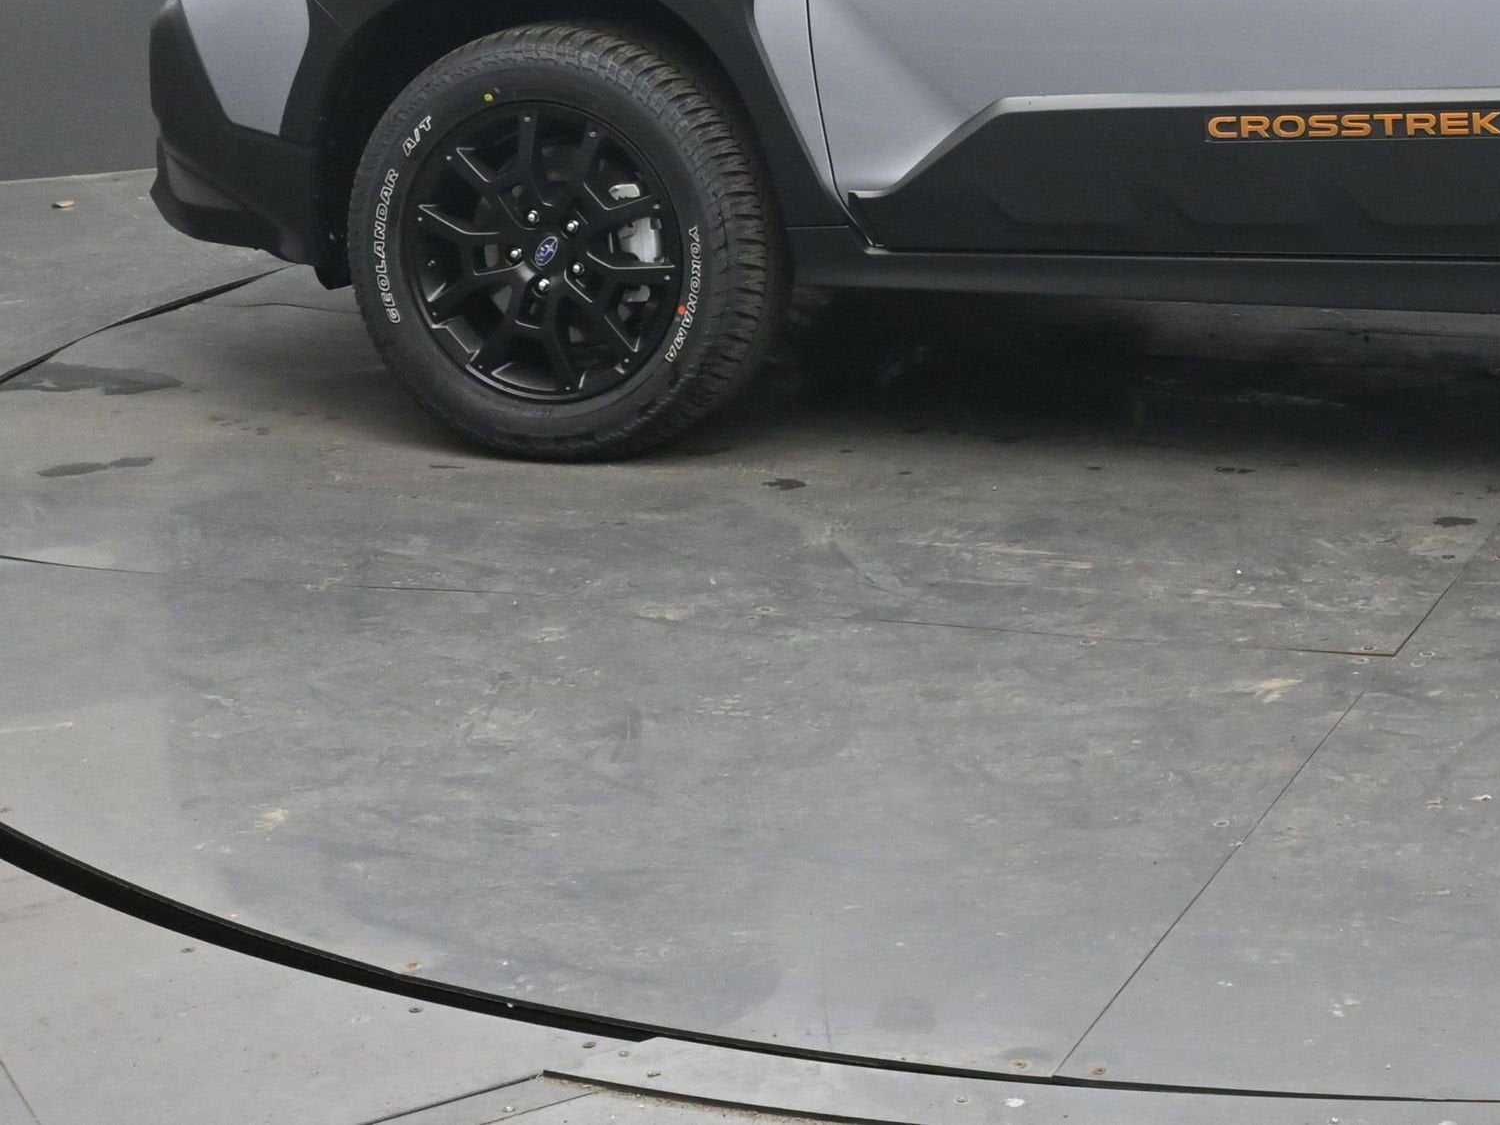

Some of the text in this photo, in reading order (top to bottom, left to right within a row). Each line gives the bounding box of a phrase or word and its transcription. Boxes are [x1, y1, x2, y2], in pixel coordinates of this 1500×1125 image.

[373, 115, 432, 324] GEOLANDAR A/T
[664, 225, 701, 362] YOKOHAMA
